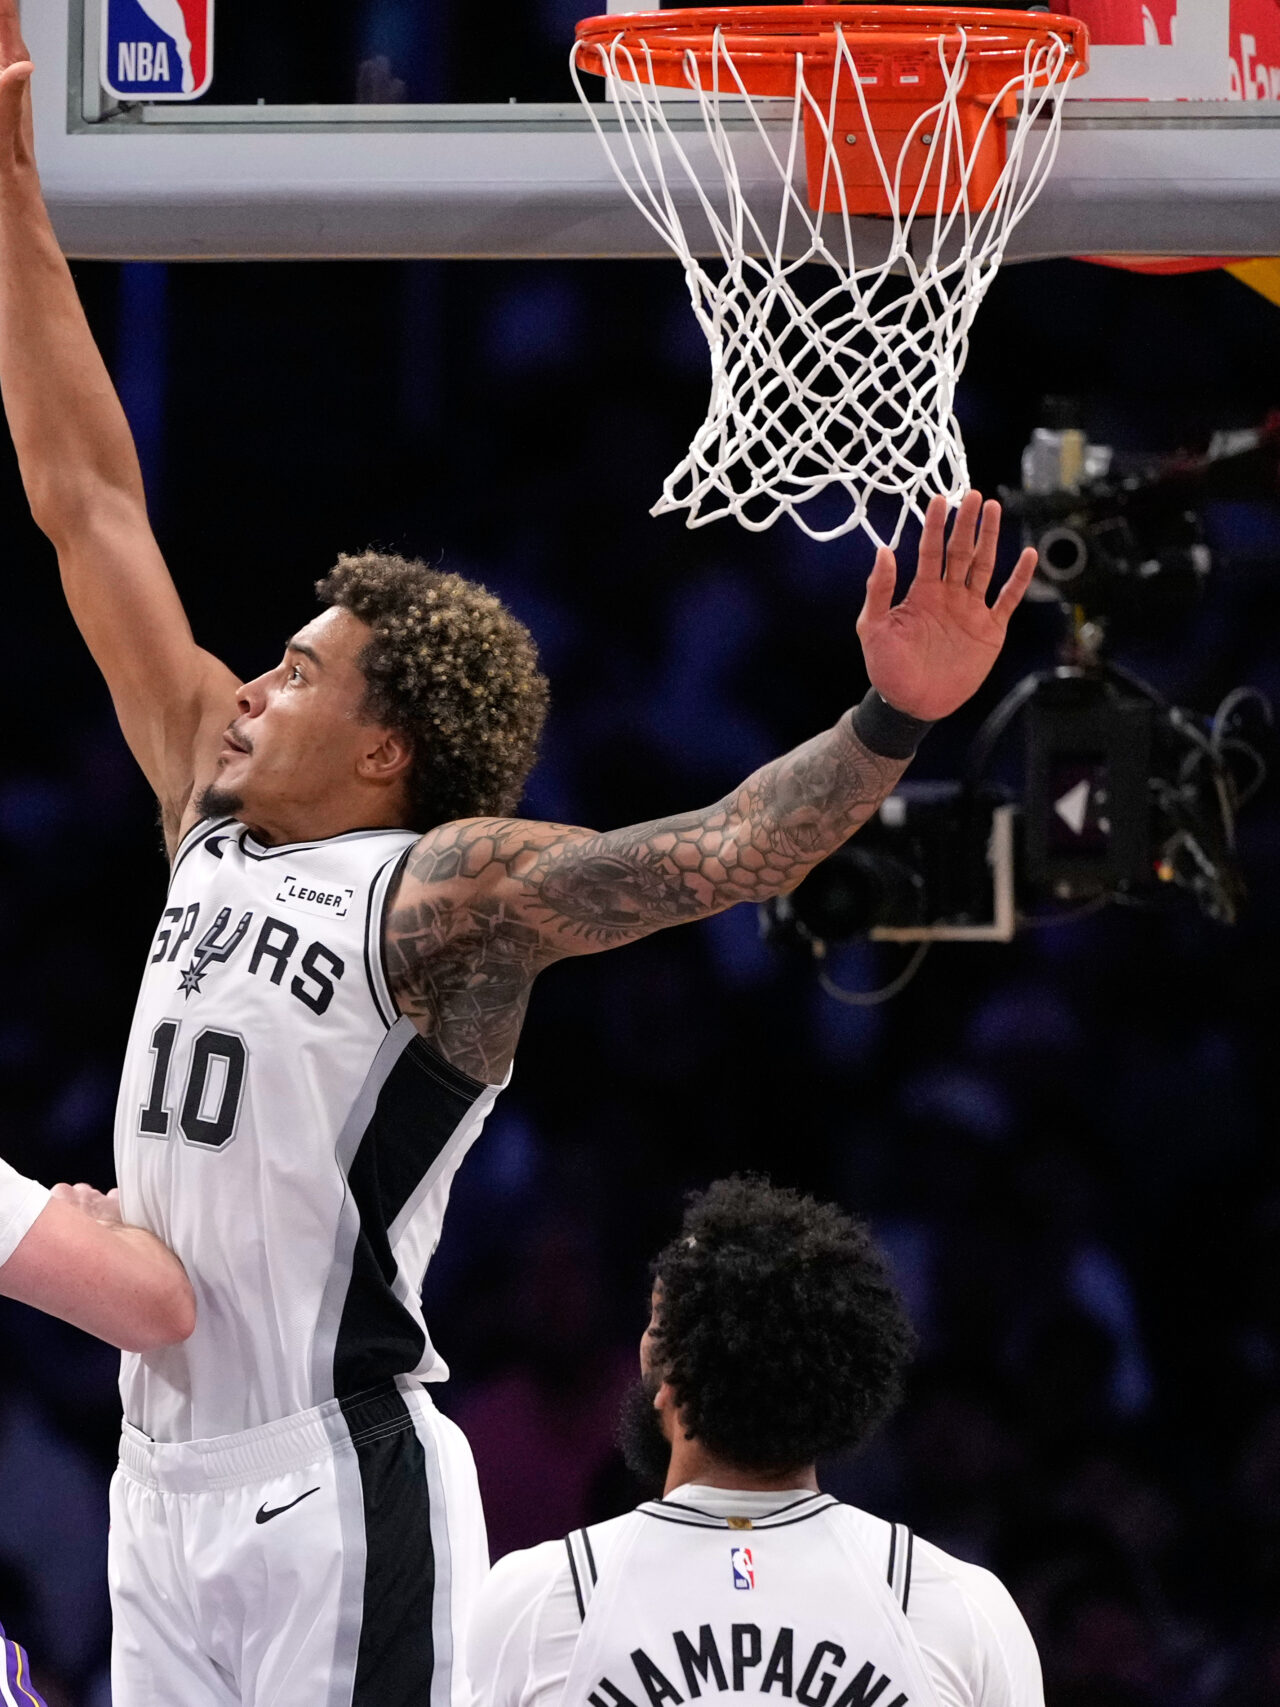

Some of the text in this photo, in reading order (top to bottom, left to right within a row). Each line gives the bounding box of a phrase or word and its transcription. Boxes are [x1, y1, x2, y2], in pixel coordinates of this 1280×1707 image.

[118, 41, 171, 82] NBA
[288, 884, 344, 909] LEDGER
[151, 901, 345, 1017] SPURS
[136, 1016, 250, 1154] 10
[587, 1623, 909, 1707] HAMPAGN
